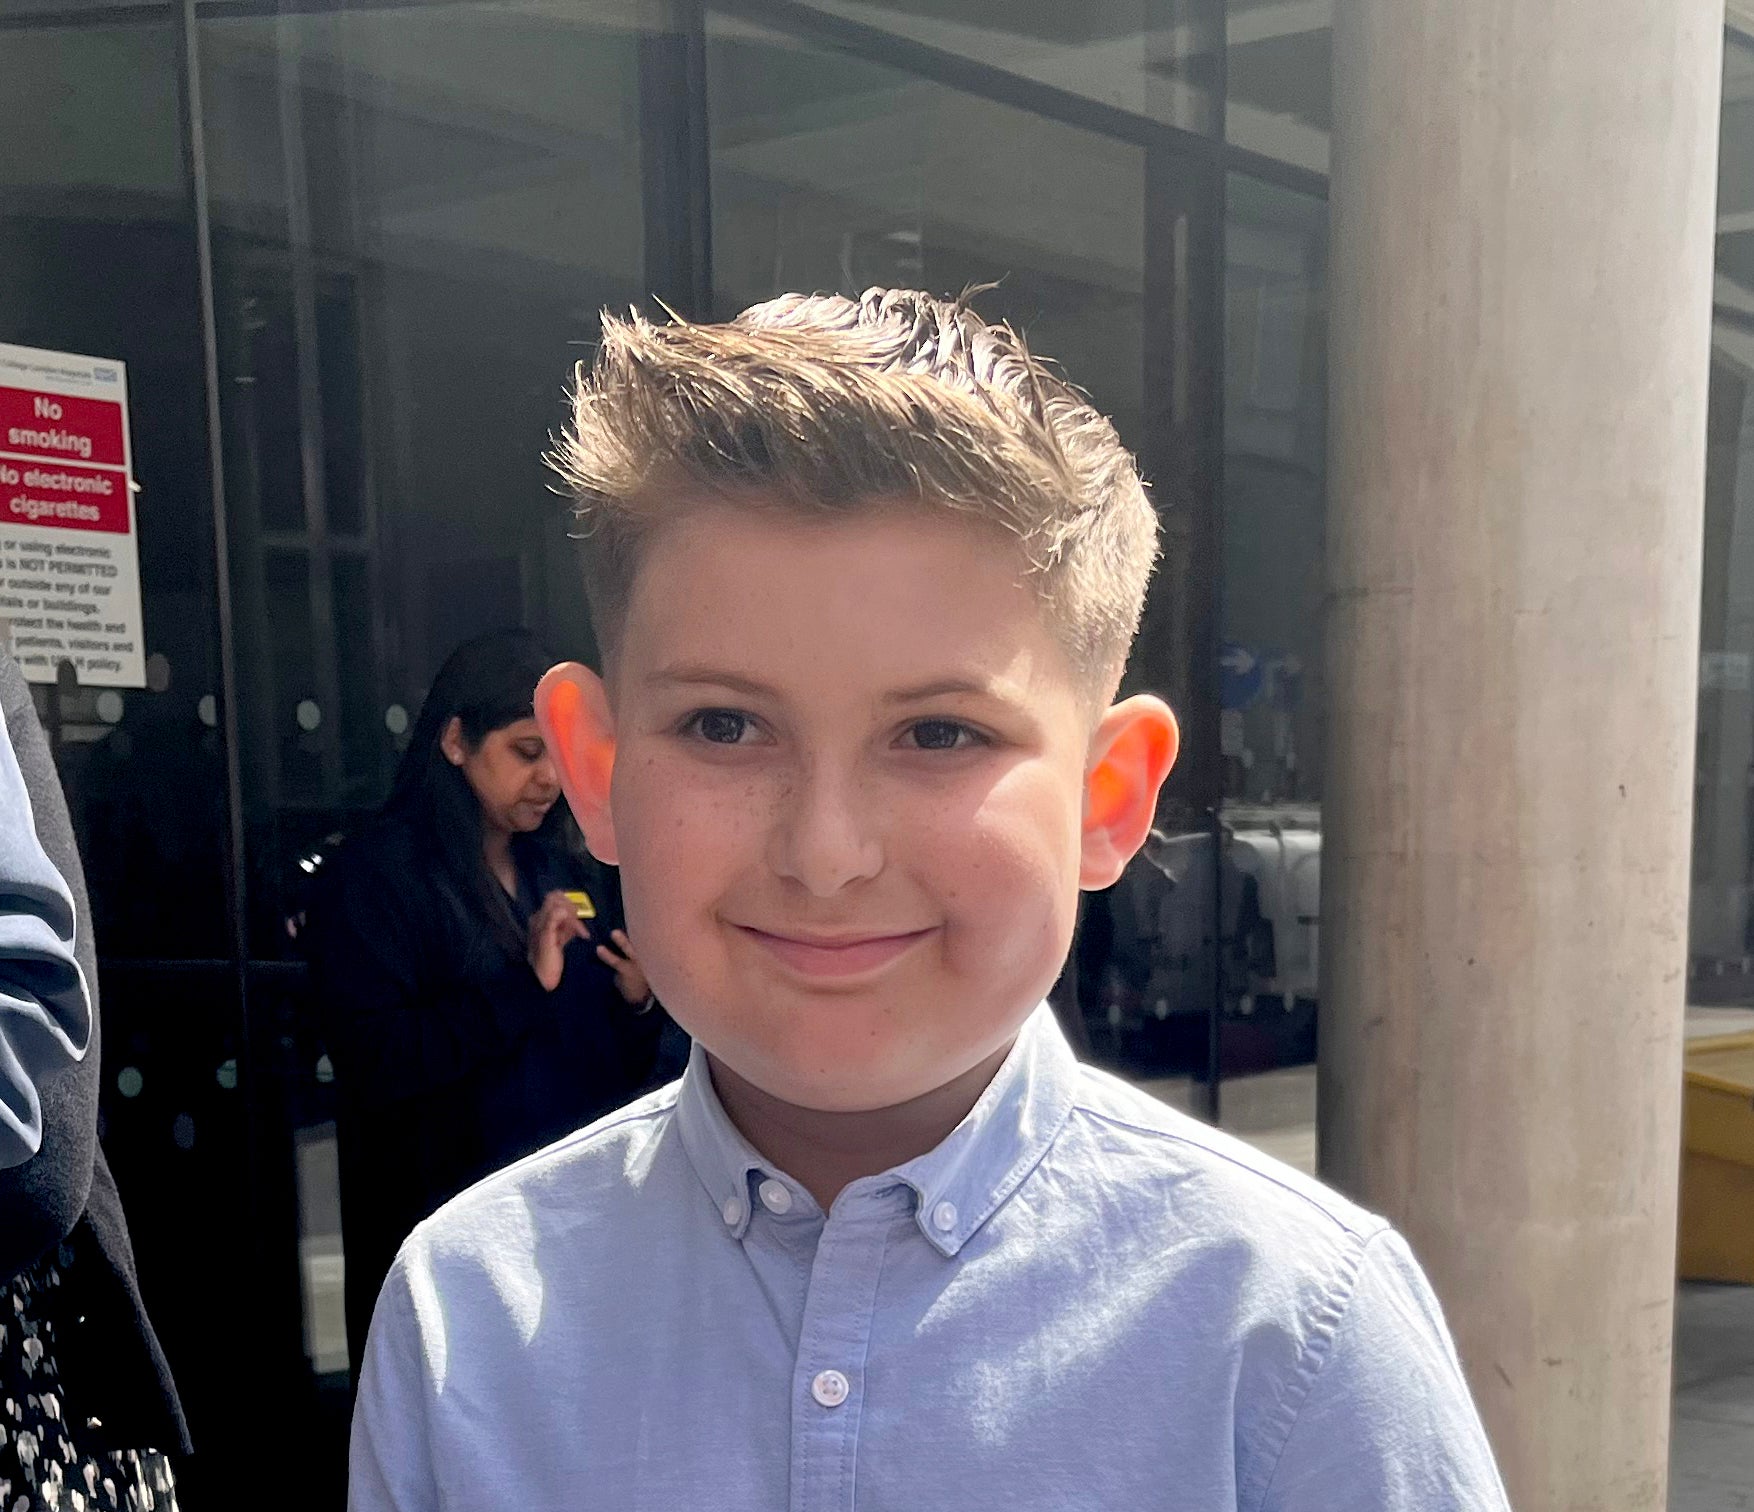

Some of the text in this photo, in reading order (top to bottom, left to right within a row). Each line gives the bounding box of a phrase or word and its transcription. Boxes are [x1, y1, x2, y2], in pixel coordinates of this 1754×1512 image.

[33, 396, 63, 421] No
[8, 427, 92, 459] smoking
[23, 467, 113, 495] electronic
[10, 494, 100, 521] cigarettes
[19, 540, 53, 557] using
[55, 544, 110, 559] electronic
[19, 558, 45, 572] NOT
[48, 559, 118, 578] PERMITTED
[7, 578, 52, 592] outside
[55, 582, 75, 597] any
[78, 581, 90, 594] of
[45, 617, 64, 631] the
[66, 618, 102, 633] health
[104, 622, 126, 635] and
[112, 642, 134, 653] and
